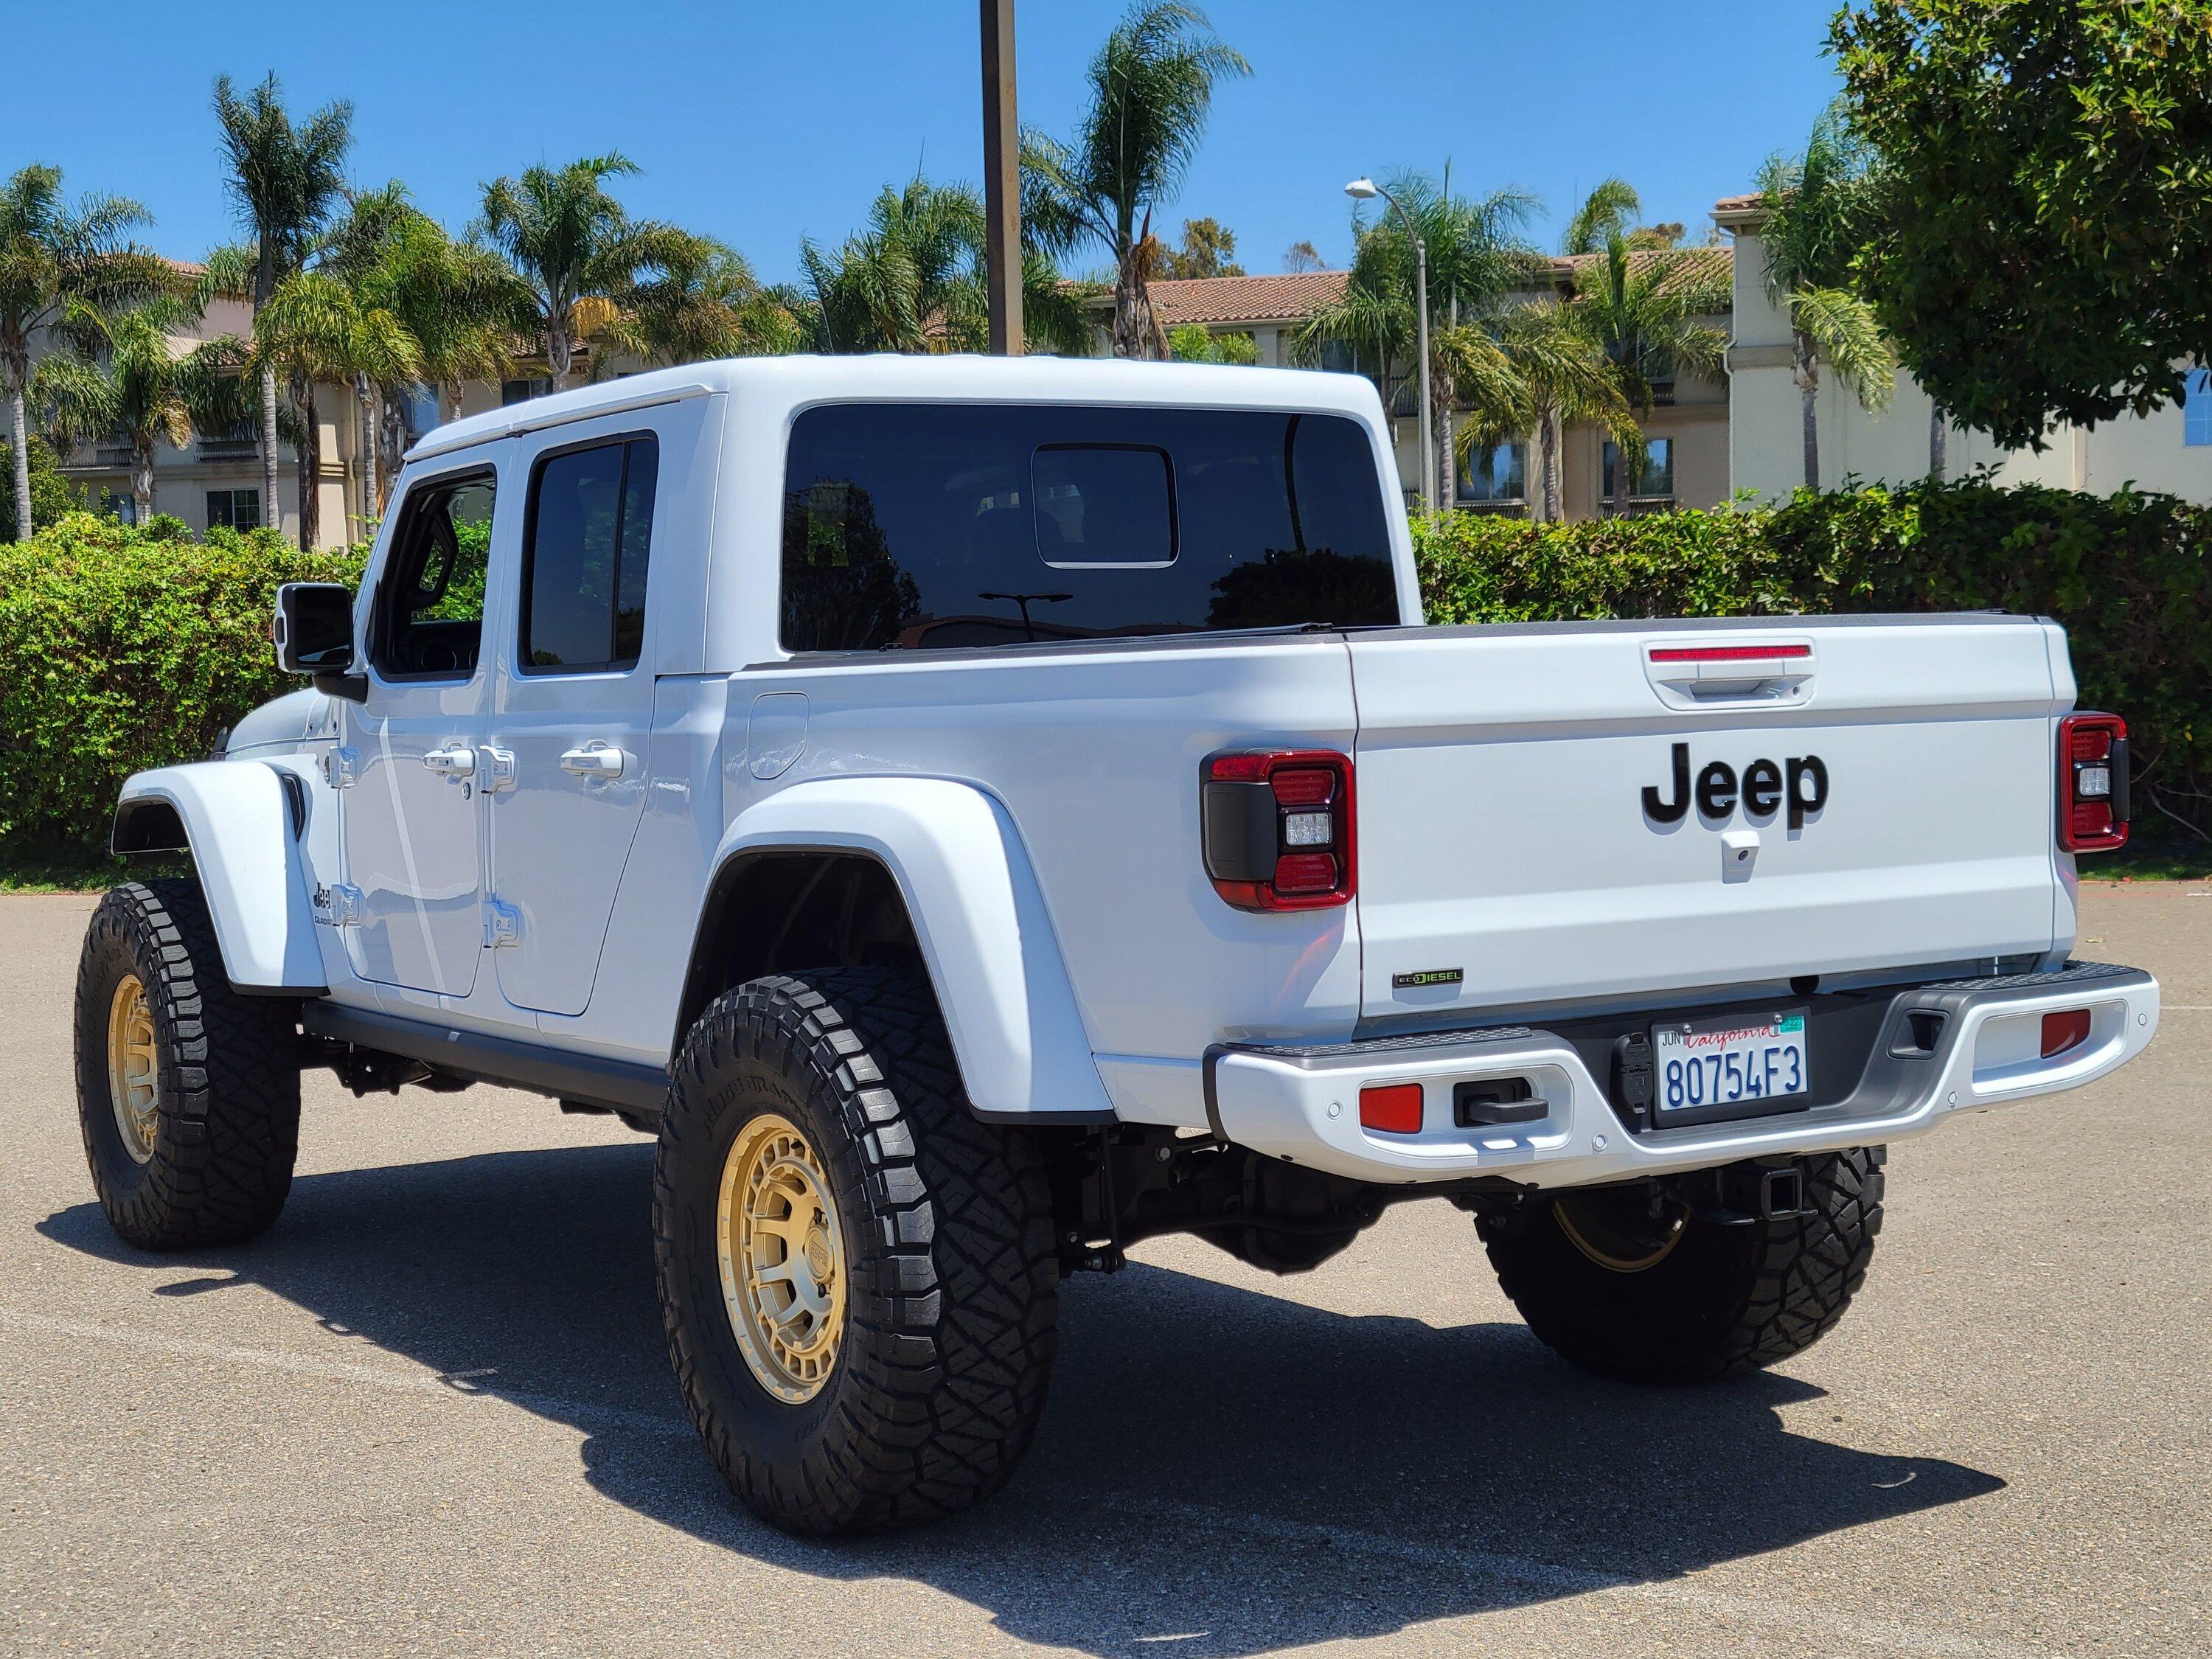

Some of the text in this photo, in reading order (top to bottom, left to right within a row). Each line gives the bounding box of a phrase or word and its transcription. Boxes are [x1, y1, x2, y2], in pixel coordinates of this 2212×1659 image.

[1641, 742, 1829, 830] Jeep
[313, 882, 331, 909] Jee
[1399, 972, 1461, 984] ECODIESEL
[1662, 1032, 1681, 1047] JUN
[1686, 1026, 1781, 1051] California
[1666, 1045, 1801, 1107] 80754F3
